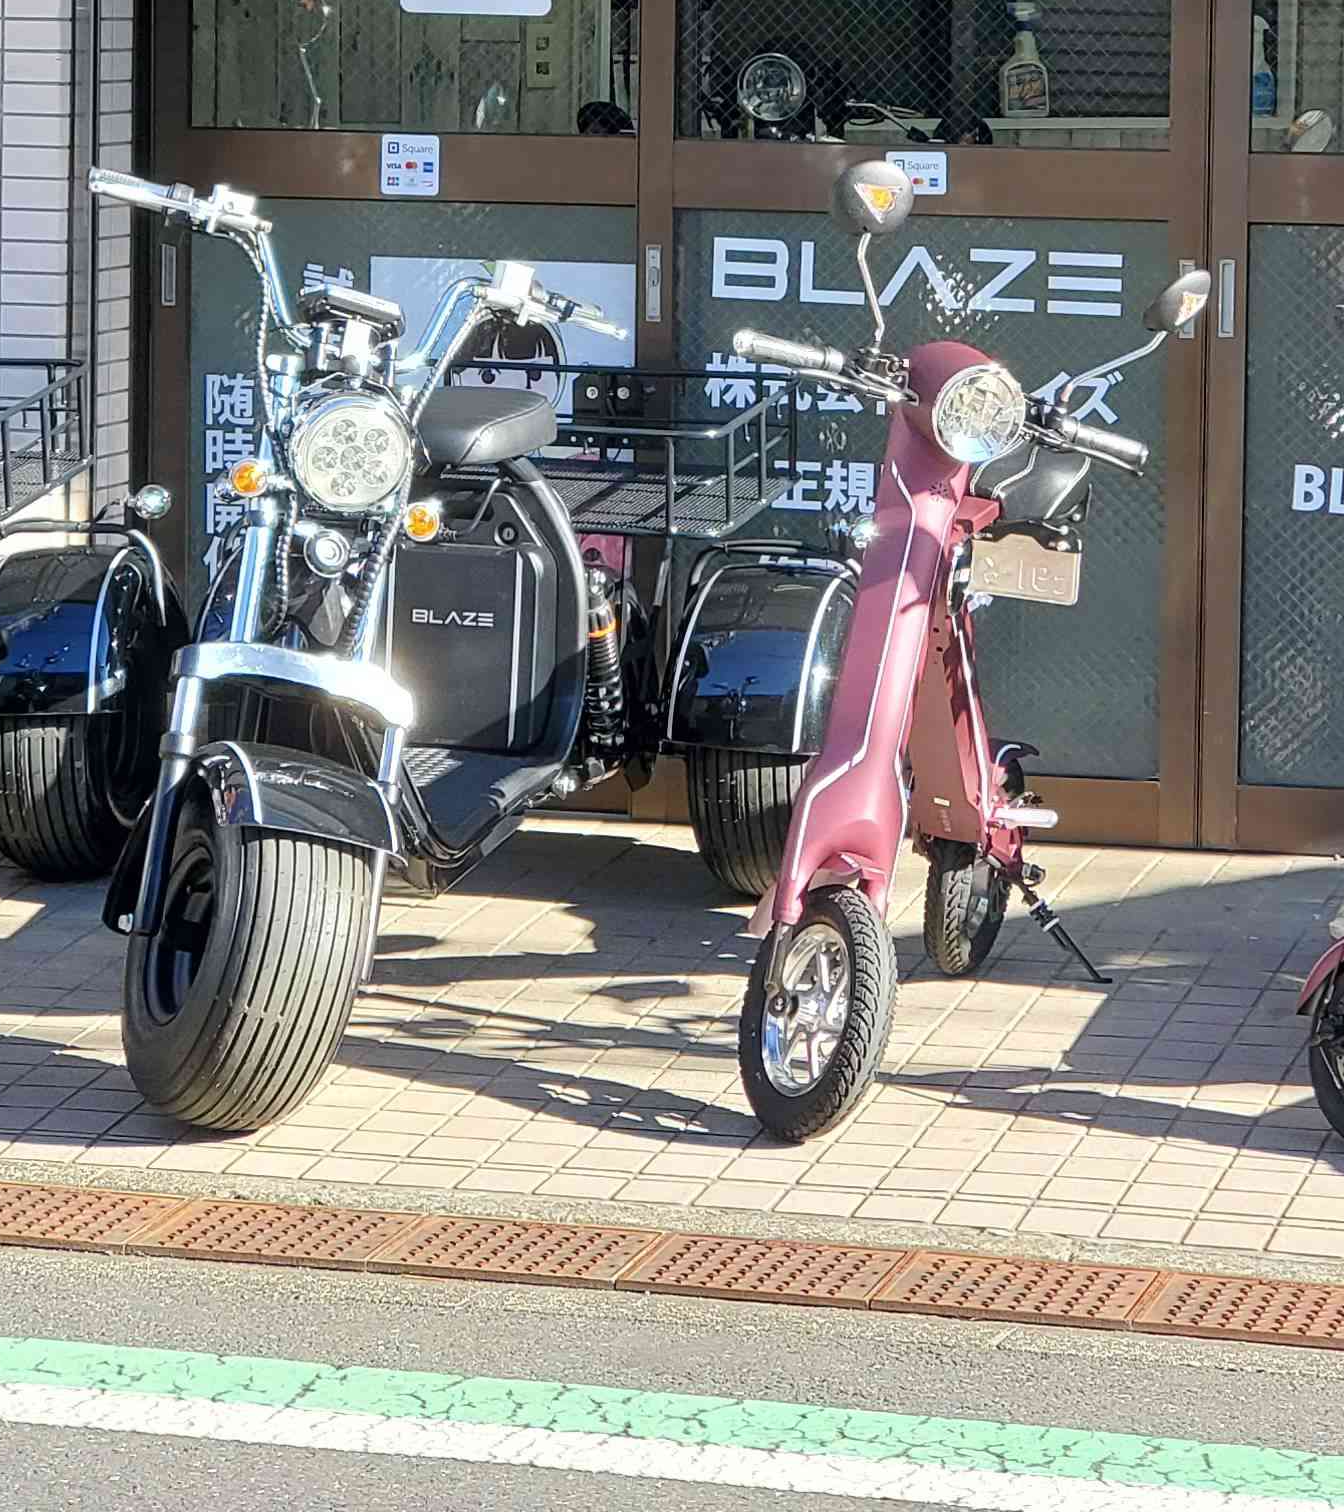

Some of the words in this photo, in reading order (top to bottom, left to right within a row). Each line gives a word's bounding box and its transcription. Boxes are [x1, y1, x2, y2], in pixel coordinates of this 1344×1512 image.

[712, 236, 1126, 318] BLAZE
[704, 352, 1124, 426] 株式会イズ
[771, 463, 885, 515] 正規
[411, 608, 494, 628] BLAZE
